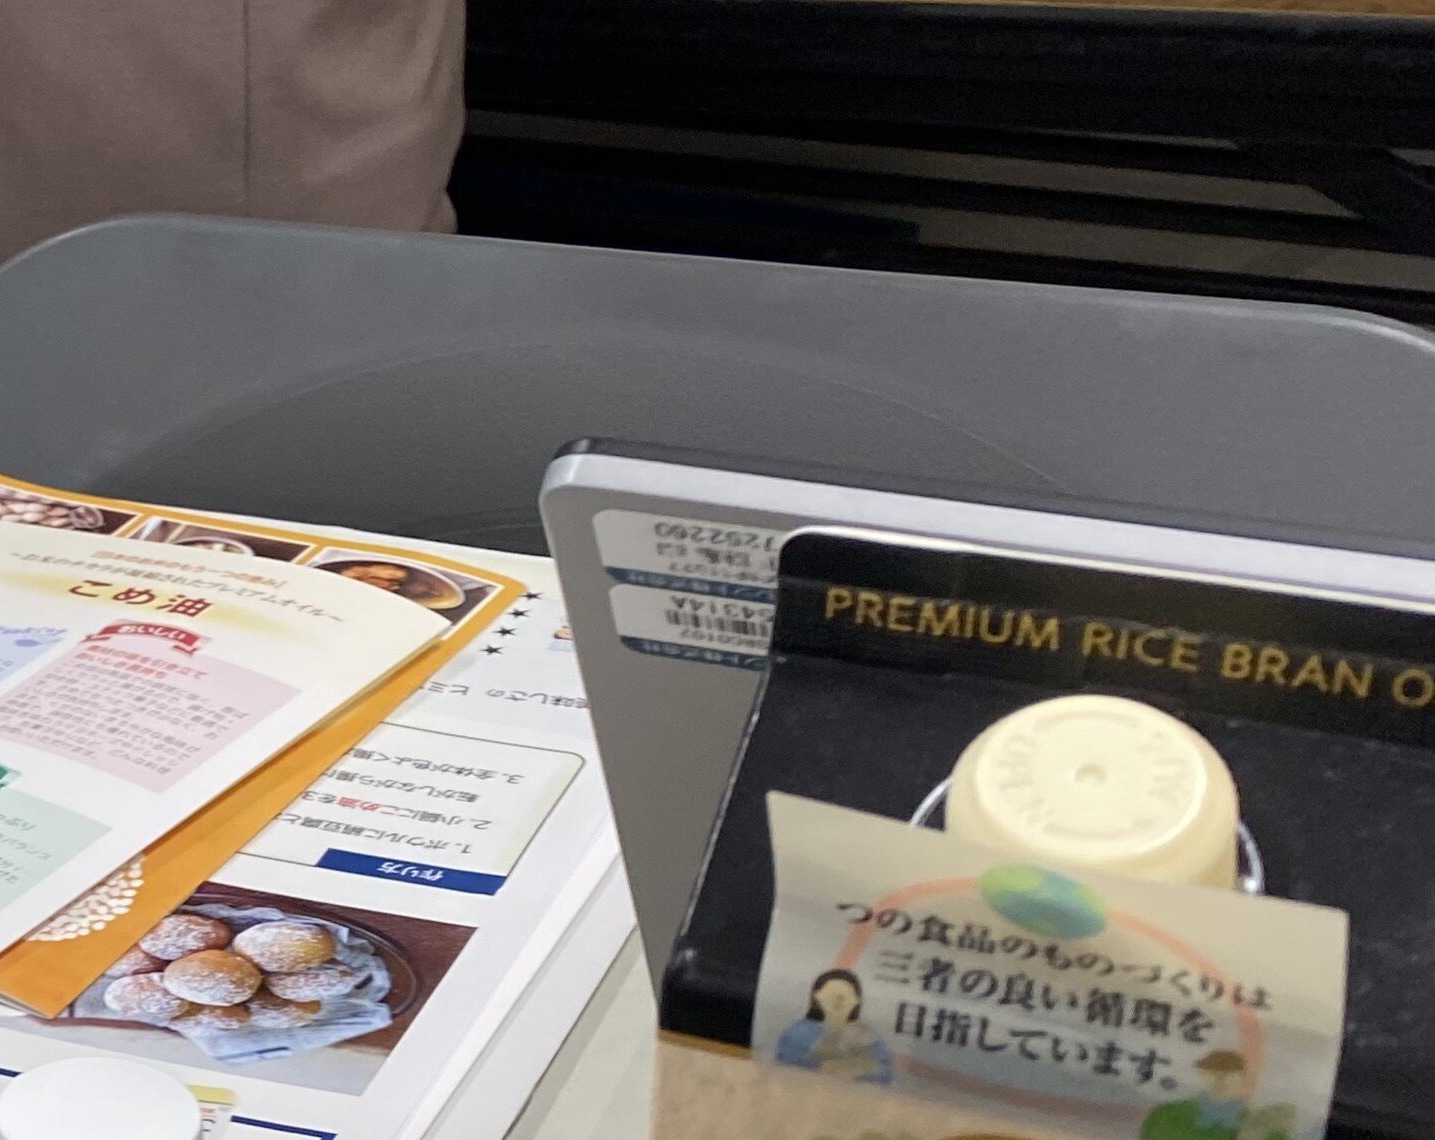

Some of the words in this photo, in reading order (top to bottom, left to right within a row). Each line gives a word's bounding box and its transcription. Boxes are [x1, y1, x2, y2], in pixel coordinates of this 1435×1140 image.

[68, 579, 214, 618] こめ油
[118, 623, 187, 641] おいしい
[824, 586, 1060, 652] PREMIUM
[1082, 620, 1199, 674] RICE
[1222, 640, 1373, 700] BRAN
[376, 860, 444, 882] 作り方
[875, 948, 1216, 1044] 三者の良い循環を
[893, 1002, 1178, 1091] 目指しています。
